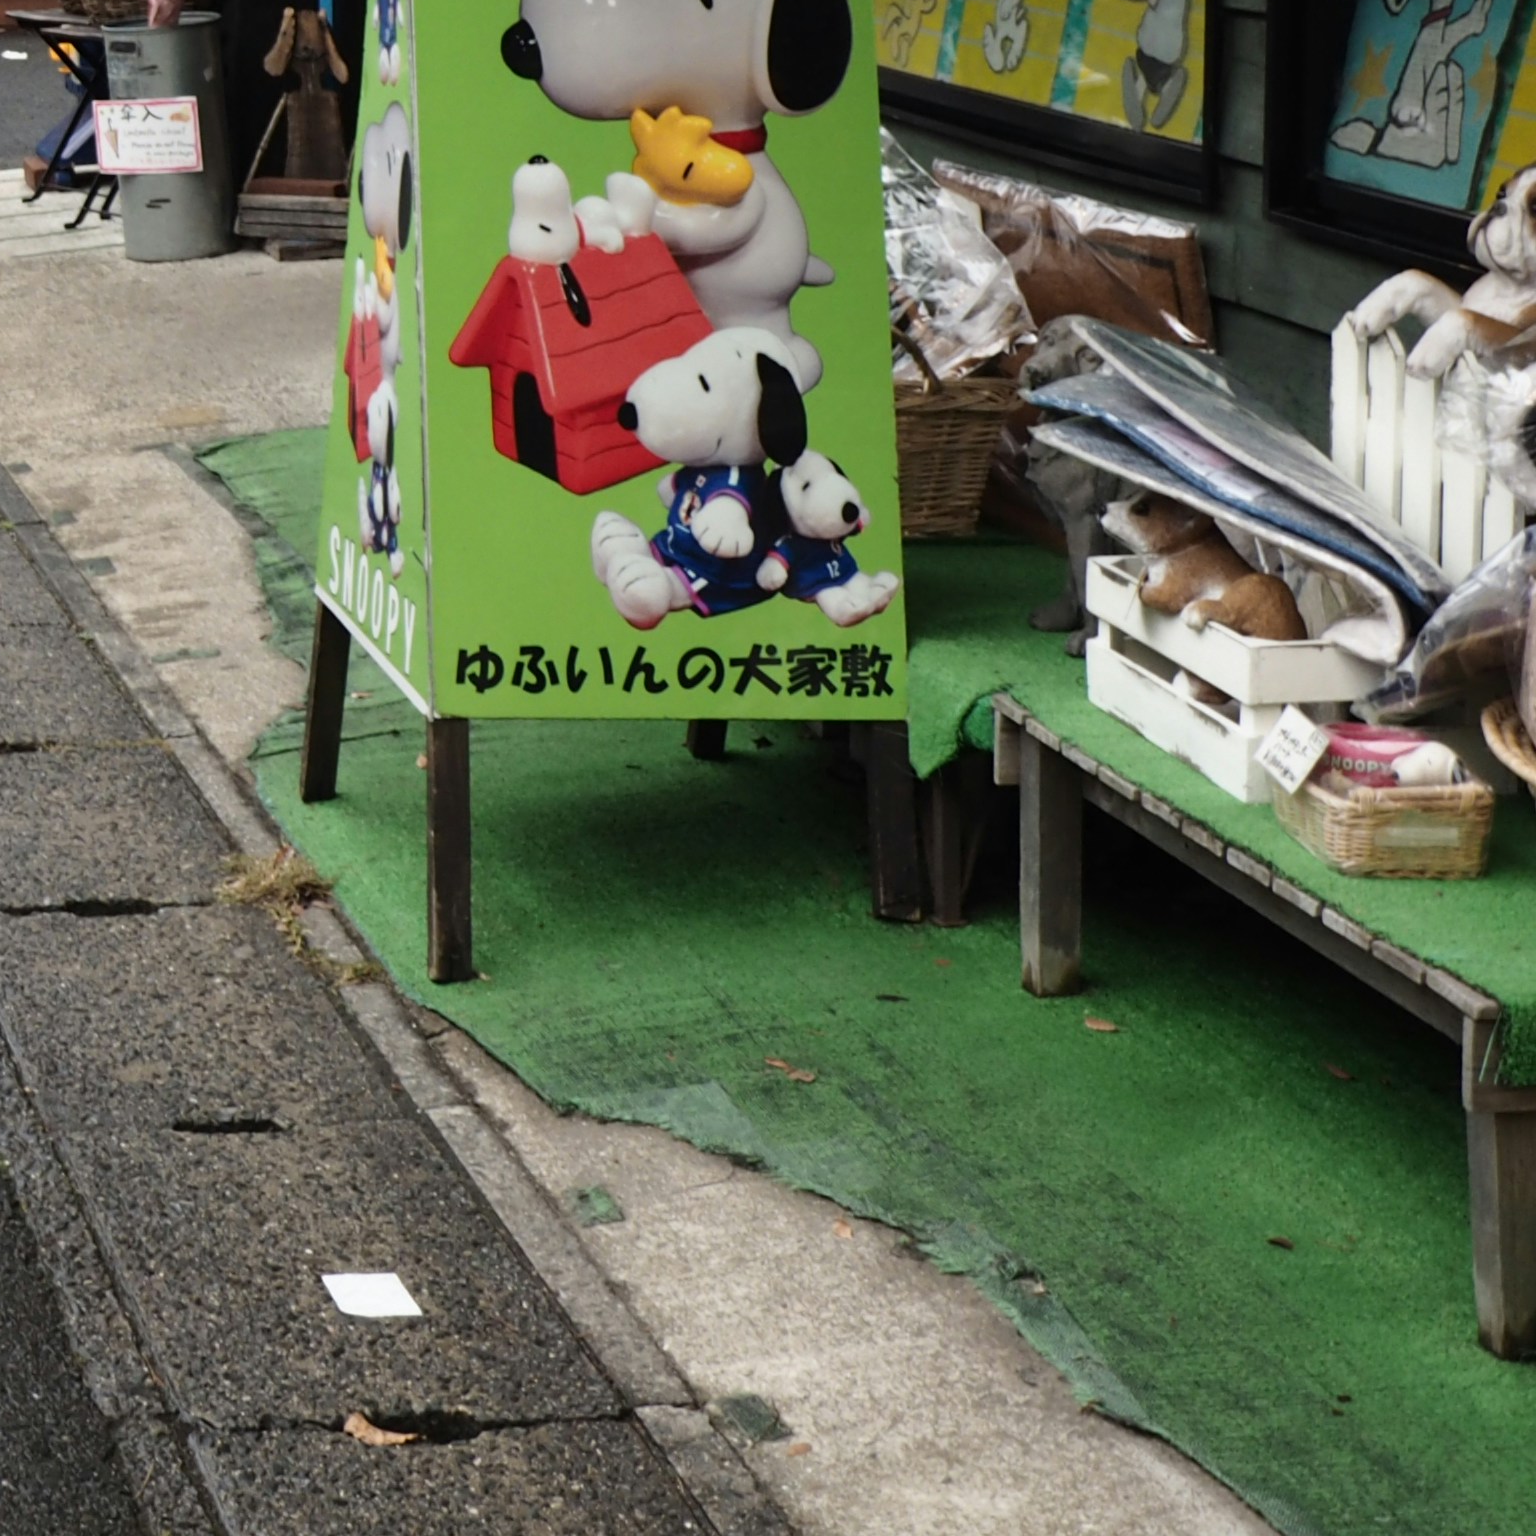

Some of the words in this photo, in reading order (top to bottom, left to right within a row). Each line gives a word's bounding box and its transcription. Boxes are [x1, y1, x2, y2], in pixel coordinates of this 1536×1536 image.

[826, 560, 840, 580] 12
[328, 522, 418, 678] SNOOPY
[455, 644, 896, 699] ゆふいんの犬家敷
